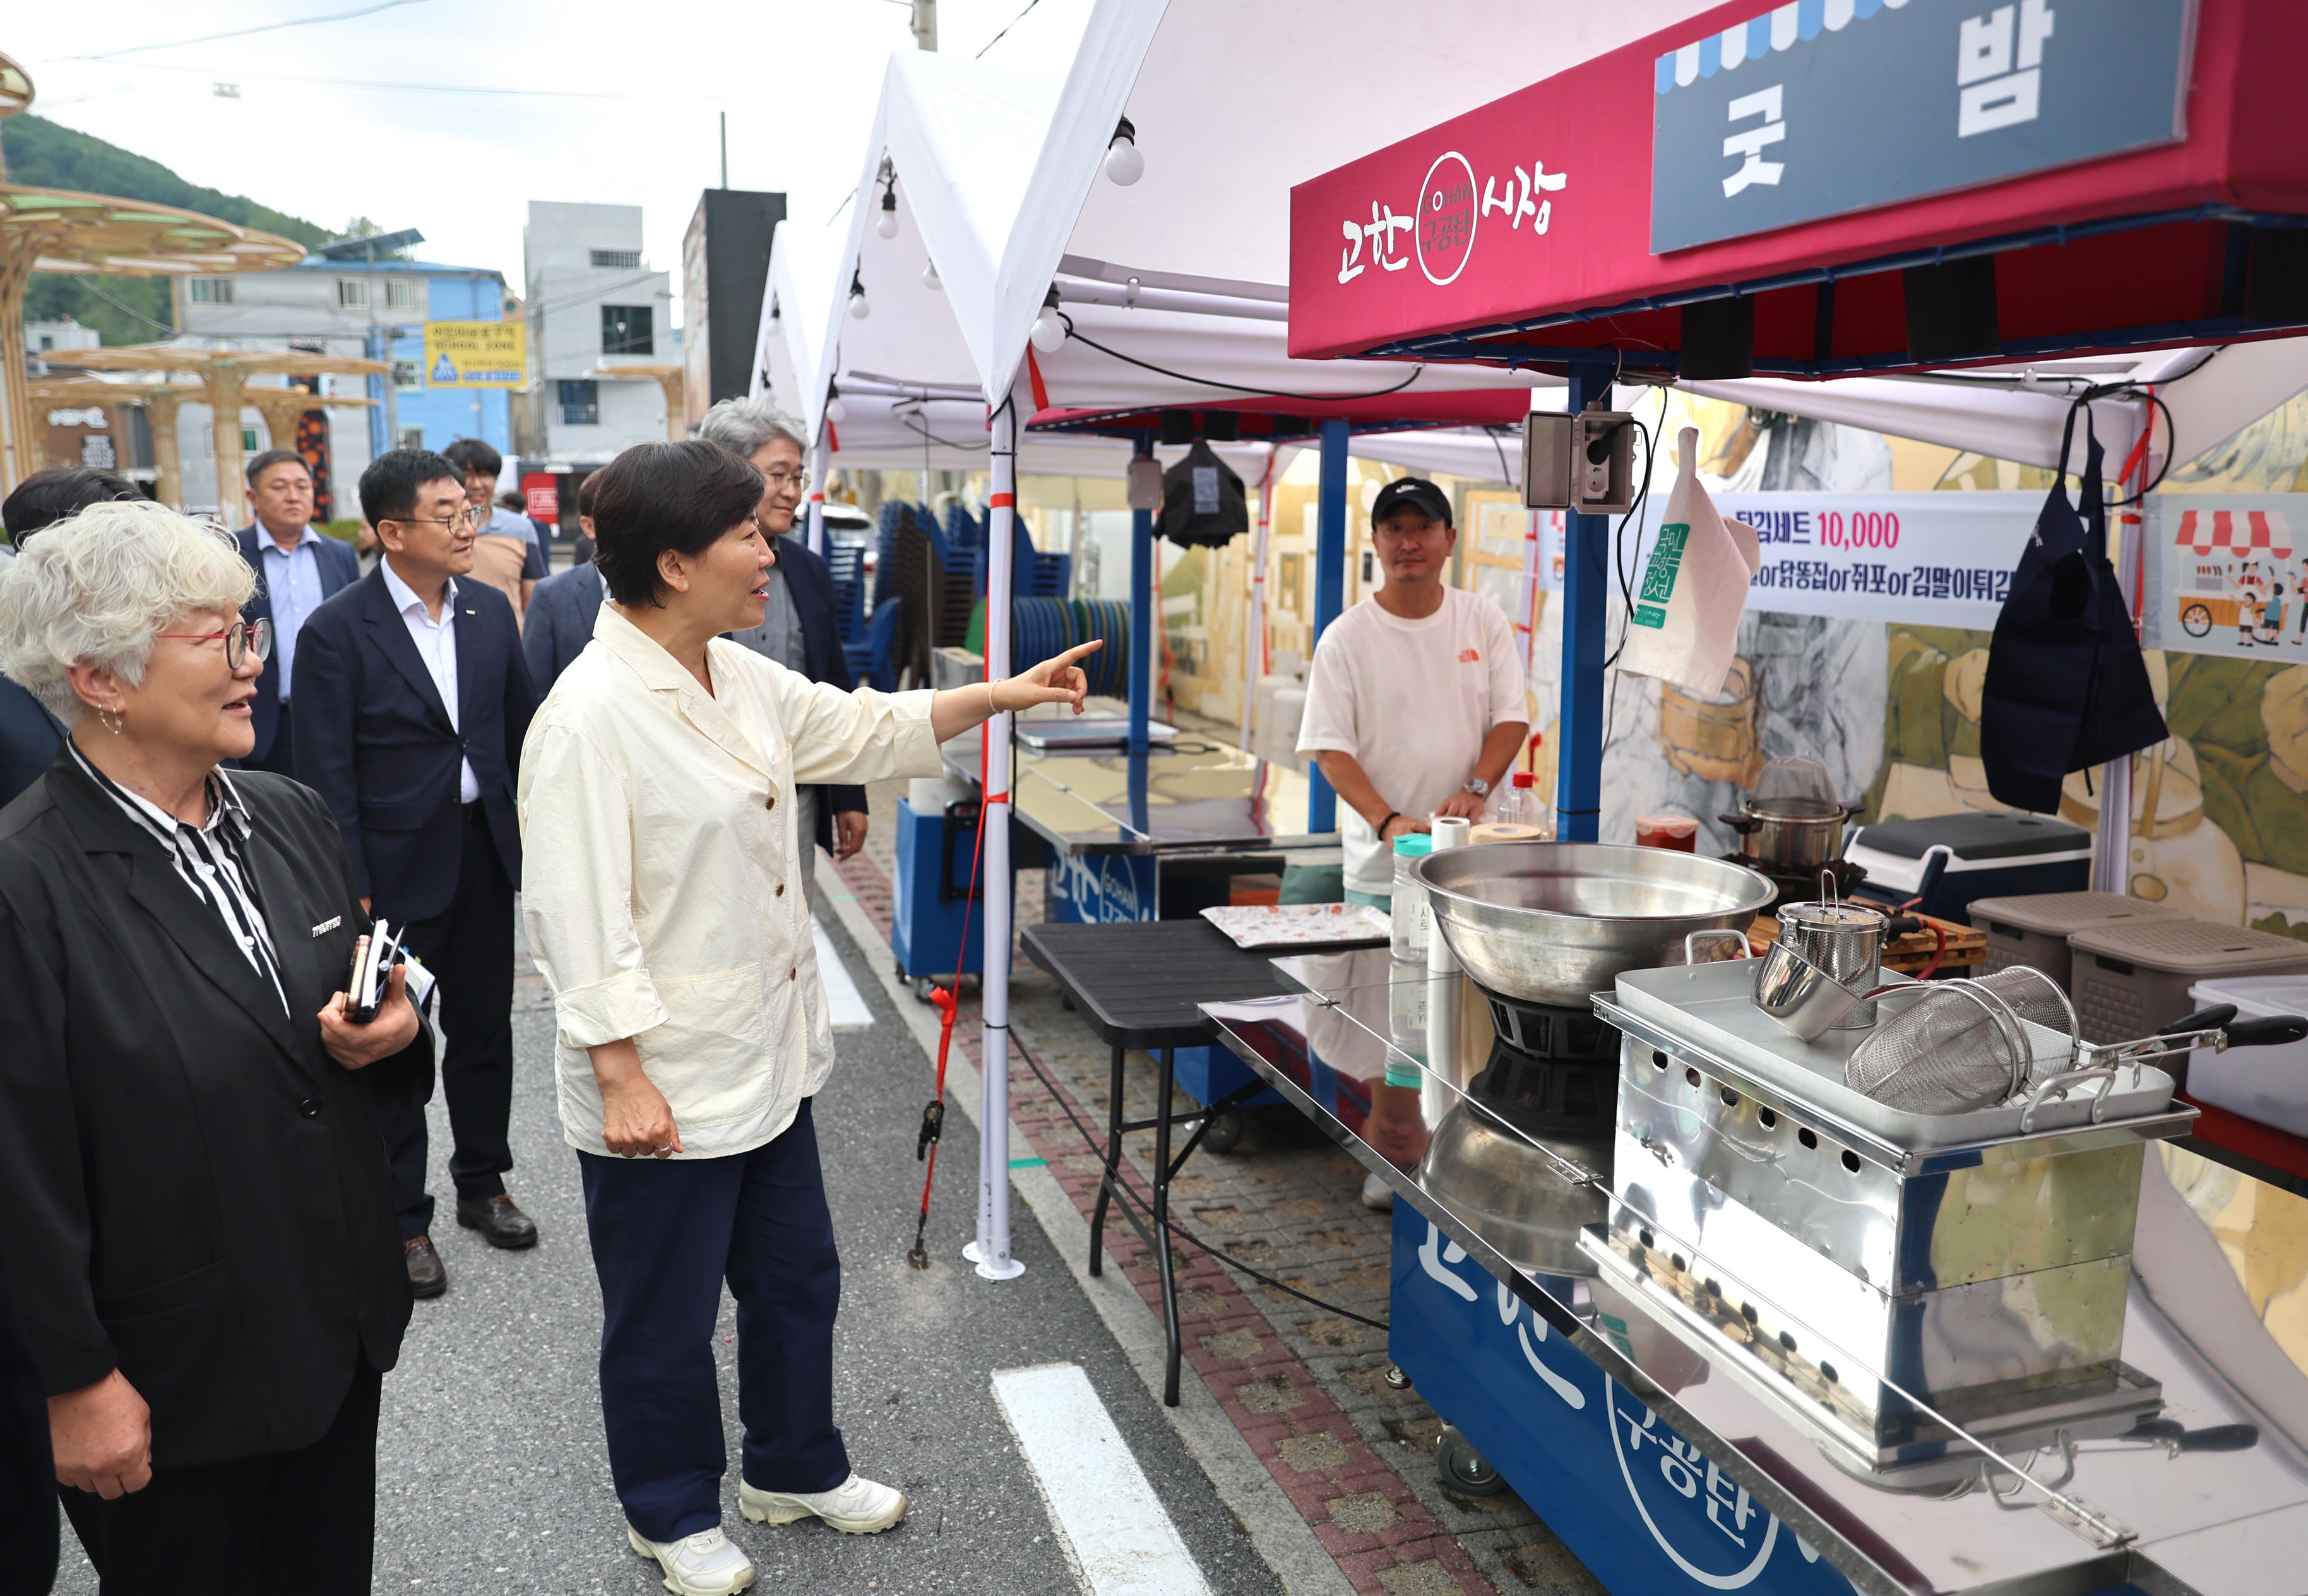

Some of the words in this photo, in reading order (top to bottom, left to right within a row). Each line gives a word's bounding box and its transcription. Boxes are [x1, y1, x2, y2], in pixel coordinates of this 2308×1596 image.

[1423, 181, 1472, 214] GOHAN
[1338, 200, 1414, 284] 고한
[1421, 209, 1471, 254] 구공탄
[1482, 160, 1567, 235] 시장
[1658, 528, 1684, 553] 국민
[1817, 511, 1900, 552] 10,000
[1648, 551, 1682, 578] 고향
[1644, 569, 1670, 600] 정선
